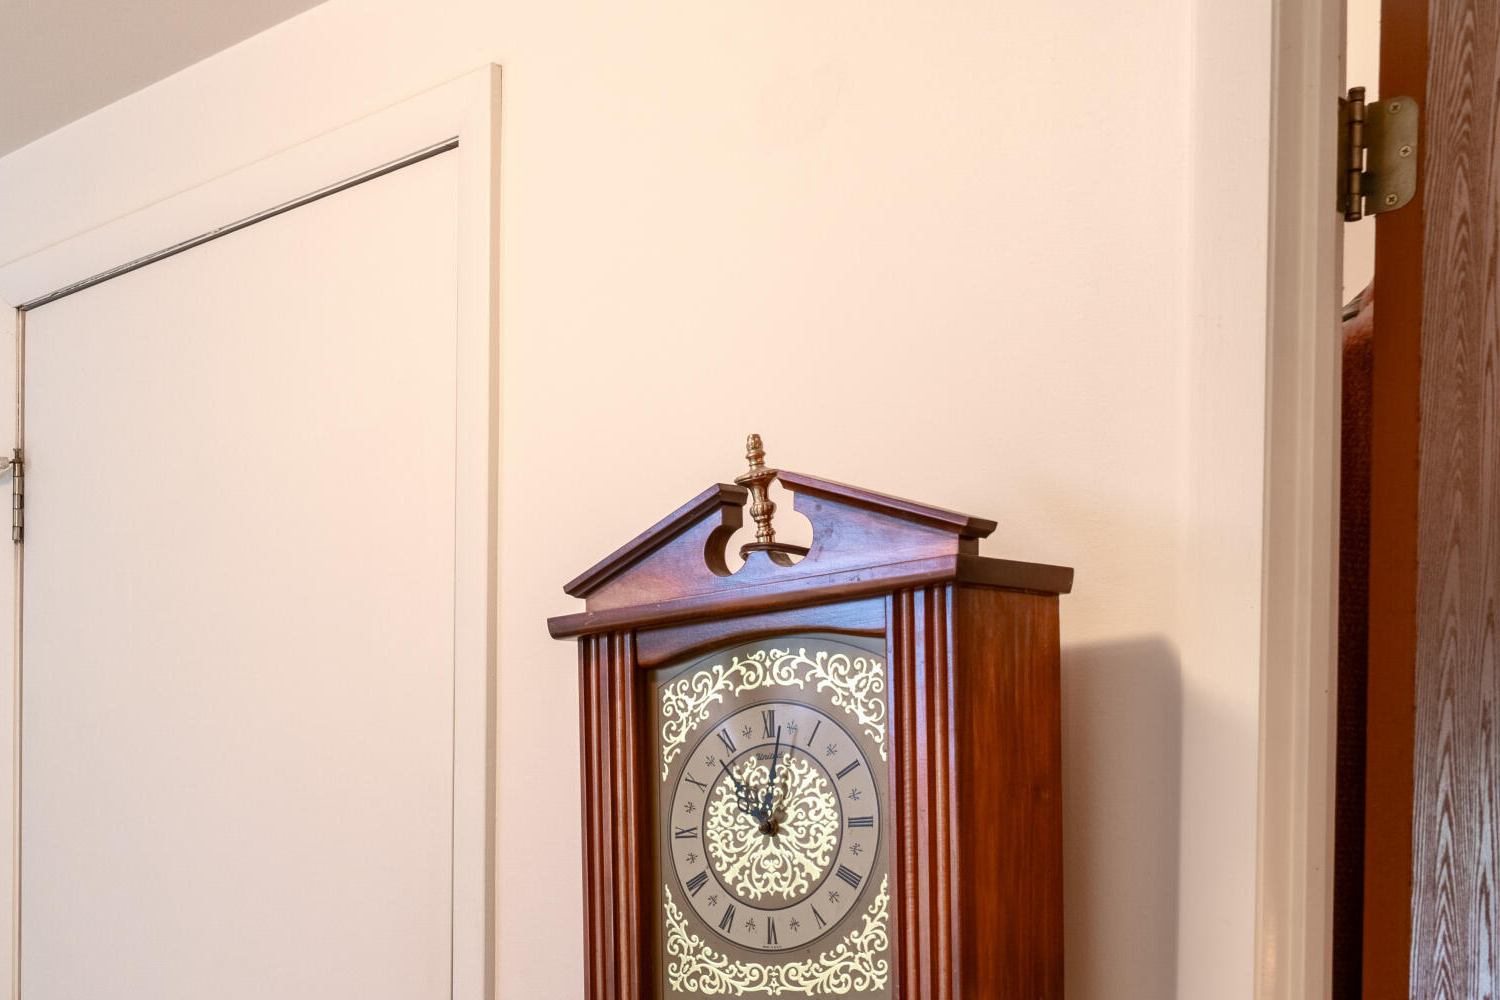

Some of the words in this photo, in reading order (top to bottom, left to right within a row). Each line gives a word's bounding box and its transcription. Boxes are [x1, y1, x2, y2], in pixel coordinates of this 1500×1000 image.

[762, 710, 776, 739] XII
[807, 720, 822, 747] I
[716, 728, 737, 757] XI
[755, 751, 784, 761] Unitd
[685, 772, 708, 793] X
[836, 759, 861, 780] II
[675, 827, 698, 839] IX
[848, 816, 874, 828] III
[686, 871, 710, 897] VIII
[718, 903, 736, 933] VII
[811, 903, 827, 930] V
[767, 916, 778, 945] VI
